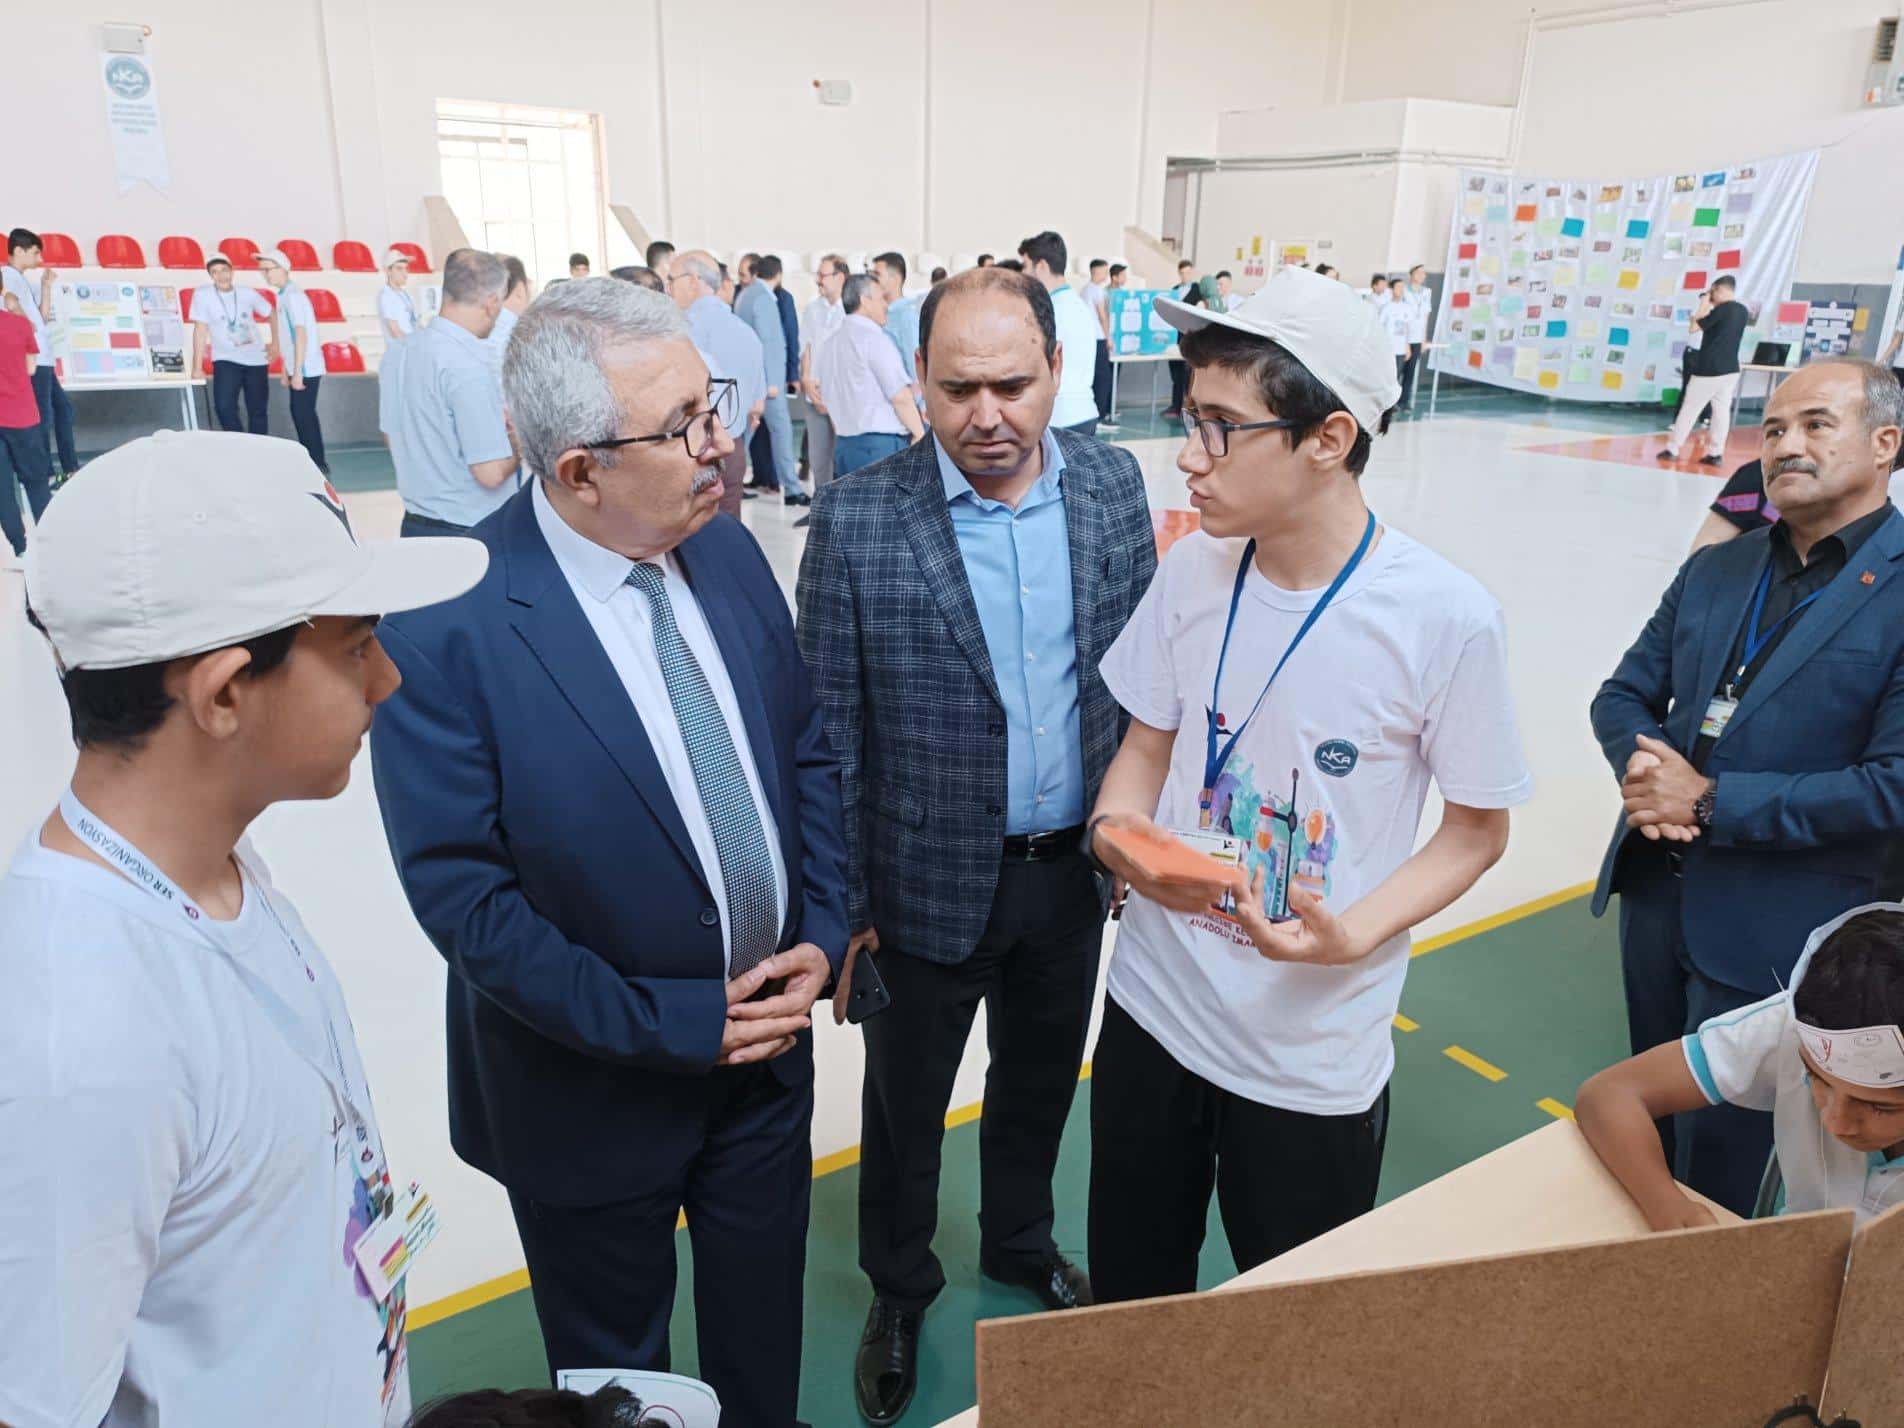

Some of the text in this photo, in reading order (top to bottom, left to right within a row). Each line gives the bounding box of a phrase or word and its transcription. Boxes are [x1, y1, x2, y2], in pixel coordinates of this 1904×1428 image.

[1321, 746, 1351, 765] NKA
[153, 879, 175, 900] SER
[1189, 917, 1230, 938] ANADOLU
